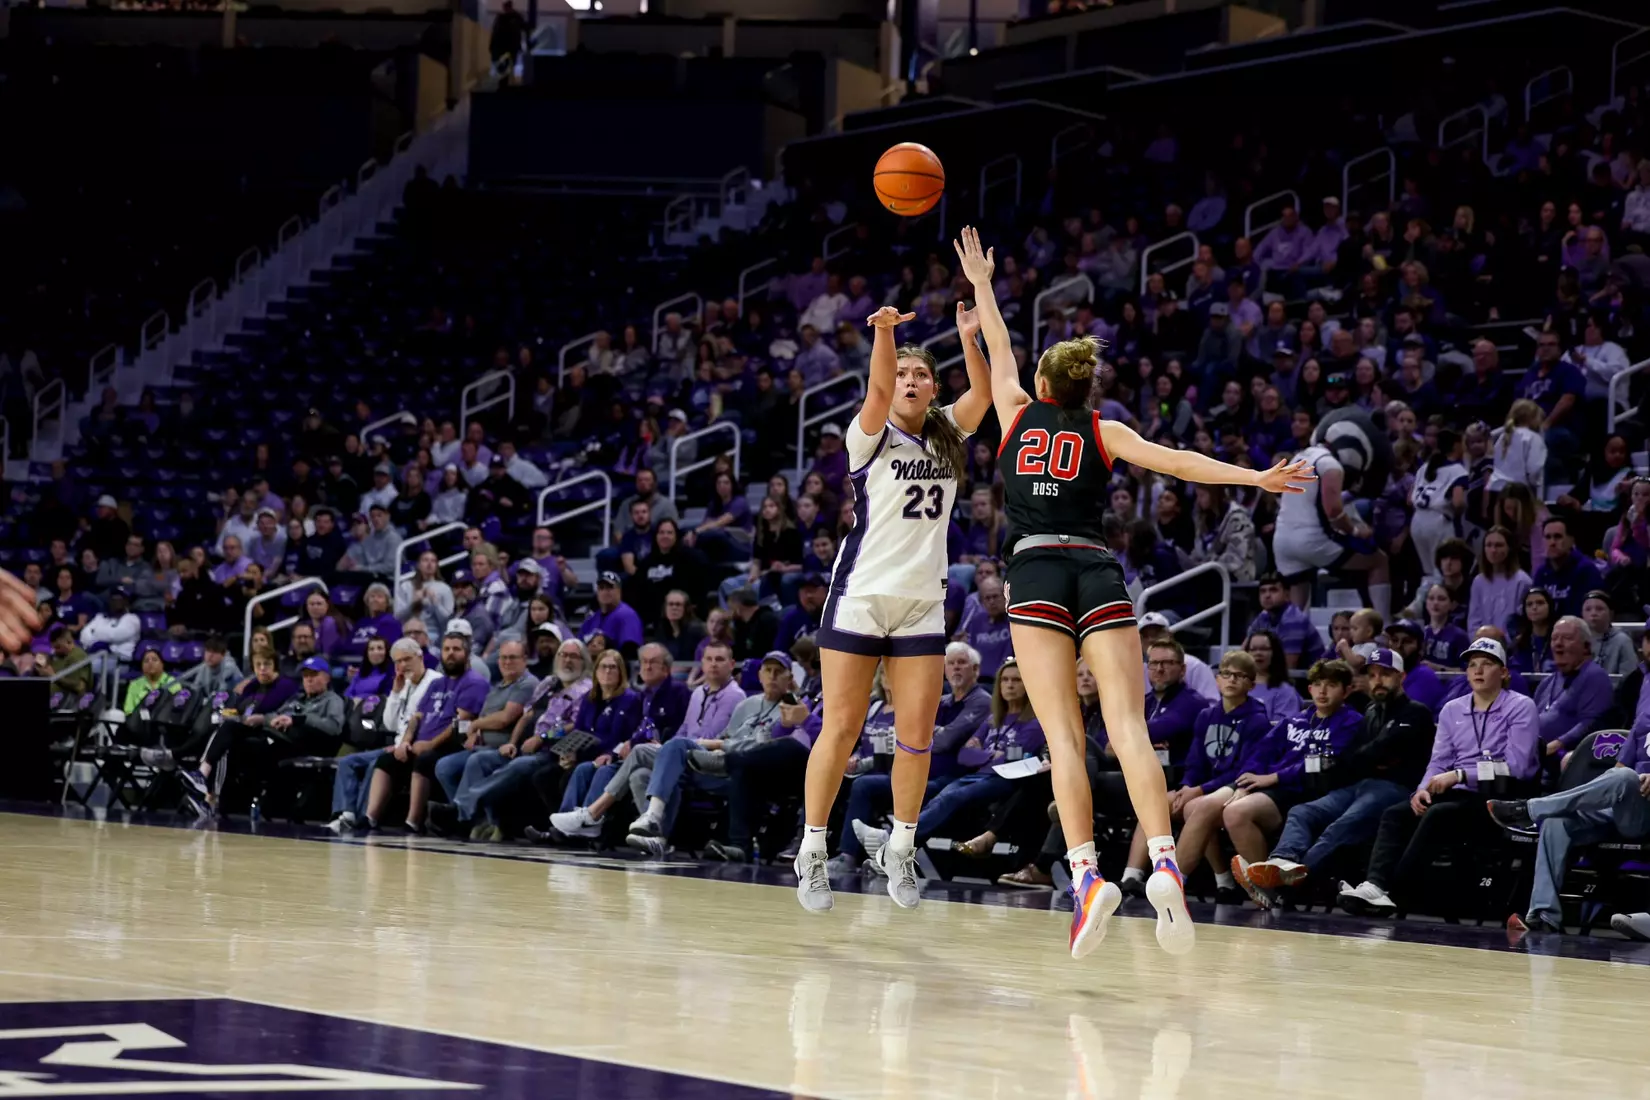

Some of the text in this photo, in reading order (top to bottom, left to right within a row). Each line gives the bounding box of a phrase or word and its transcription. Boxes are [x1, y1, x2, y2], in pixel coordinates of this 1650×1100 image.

[1016, 428, 1084, 481] 20
[1032, 482, 1059, 496] ROSS
[903, 484, 944, 520] 23
[1479, 877, 1492, 887] 26
[1583, 884, 1596, 893] 27
